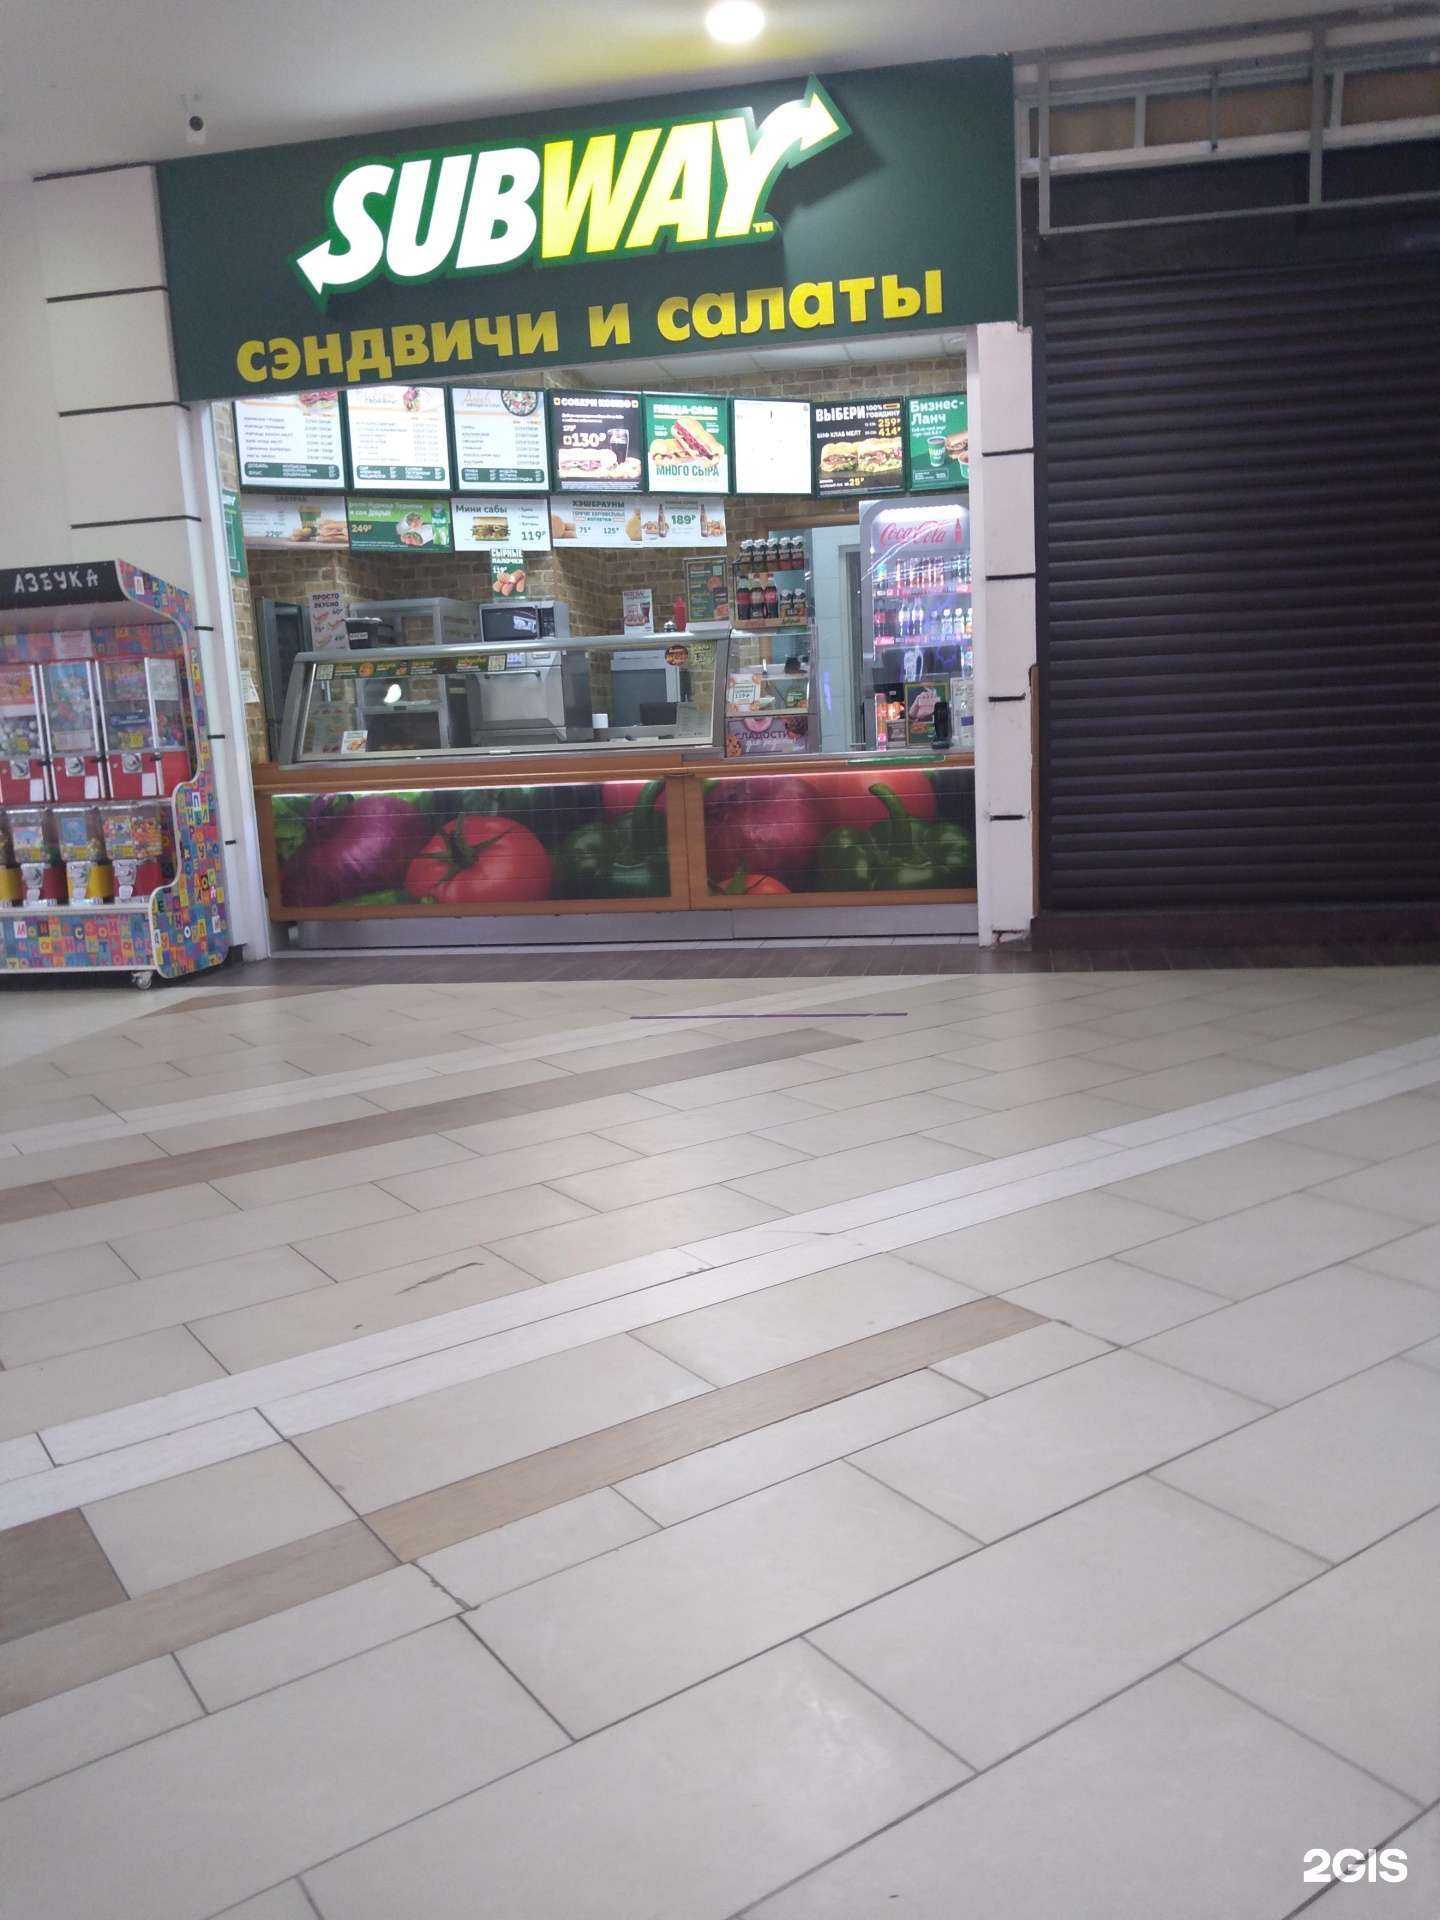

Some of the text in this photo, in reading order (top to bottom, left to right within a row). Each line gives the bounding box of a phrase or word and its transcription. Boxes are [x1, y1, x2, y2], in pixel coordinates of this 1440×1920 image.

[297, 93, 839, 294] SUBWAY
[236, 270, 943, 383] сэндвичи и салаты
[815, 405, 866, 422] ВЫБЕРИ
[911, 413, 946, 425] Ланч
[656, 464, 719, 476] МНОГО СЫРА
[455, 504, 507, 513] Мини сабы
[14, 569, 98, 593] АЗБУКА
